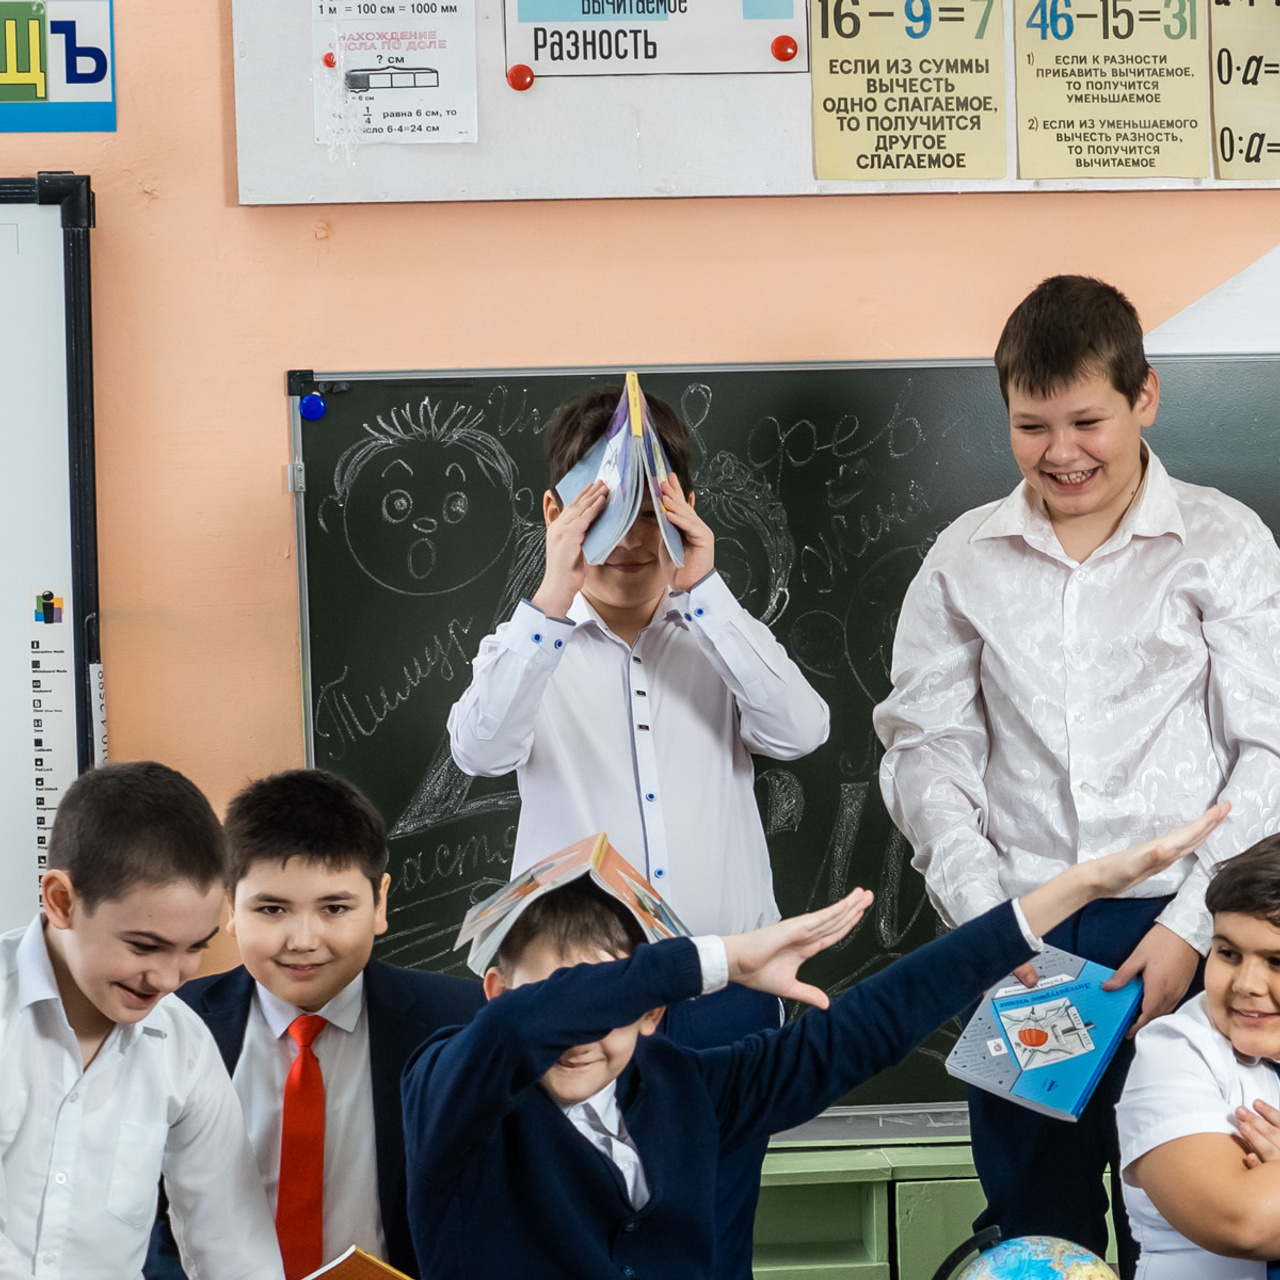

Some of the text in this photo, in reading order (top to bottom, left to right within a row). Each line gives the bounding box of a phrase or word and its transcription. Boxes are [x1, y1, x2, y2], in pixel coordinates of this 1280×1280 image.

[357, 3, 457, 14] 100 см 1000 мм
[381, 40, 447, 52] ПО ДОЛЕ
[533, 27, 657, 61] Разность
[51, 20, 107, 84] Ъ
[388, 56, 405, 64] см
[1054, 55, 1087, 65] ЕСЛИ
[1092, 55, 1100, 65] К
[1103, 54, 1168, 65] РАЗНОСТИ
[828, 58, 990, 74] ЕСЛИ ИЗ СУММЫ
[1036, 68, 1107, 78] ПРИБАВИТЬ
[866, 77, 956, 93] ВЫЧЕСТЬ
[1066, 80, 1159, 91] ТО ПОЛУЧИТСЯ
[1066, 93, 1162, 104] УМЕНЬШАЕМОЕ
[822, 96, 998, 114] ОДНО СЛАГАЕМОЕ,
[382, 109, 457, 119] равна 6 см, то
[836, 115, 981, 132] ТО ПОЛУЧИТСЯ
[1043, 120, 1075, 130] ЕСЛИ
[1079, 119, 1095, 129] ИЗ
[1099, 119, 1198, 129] УМЕНЬШАЕМОГО
[874, 134, 947, 152] ДРУГОЕ
[1056, 132, 1183, 143] ВЫЧЕСТЬ РАЗНОСТЬ,
[1067, 145, 1160, 155] ТО ПОЛУЧИТСЯ
[856, 153, 967, 169] СЛАГАЕМОЕ
[1076, 158, 1156, 168] ВЫЧИТАЕМОЕ
